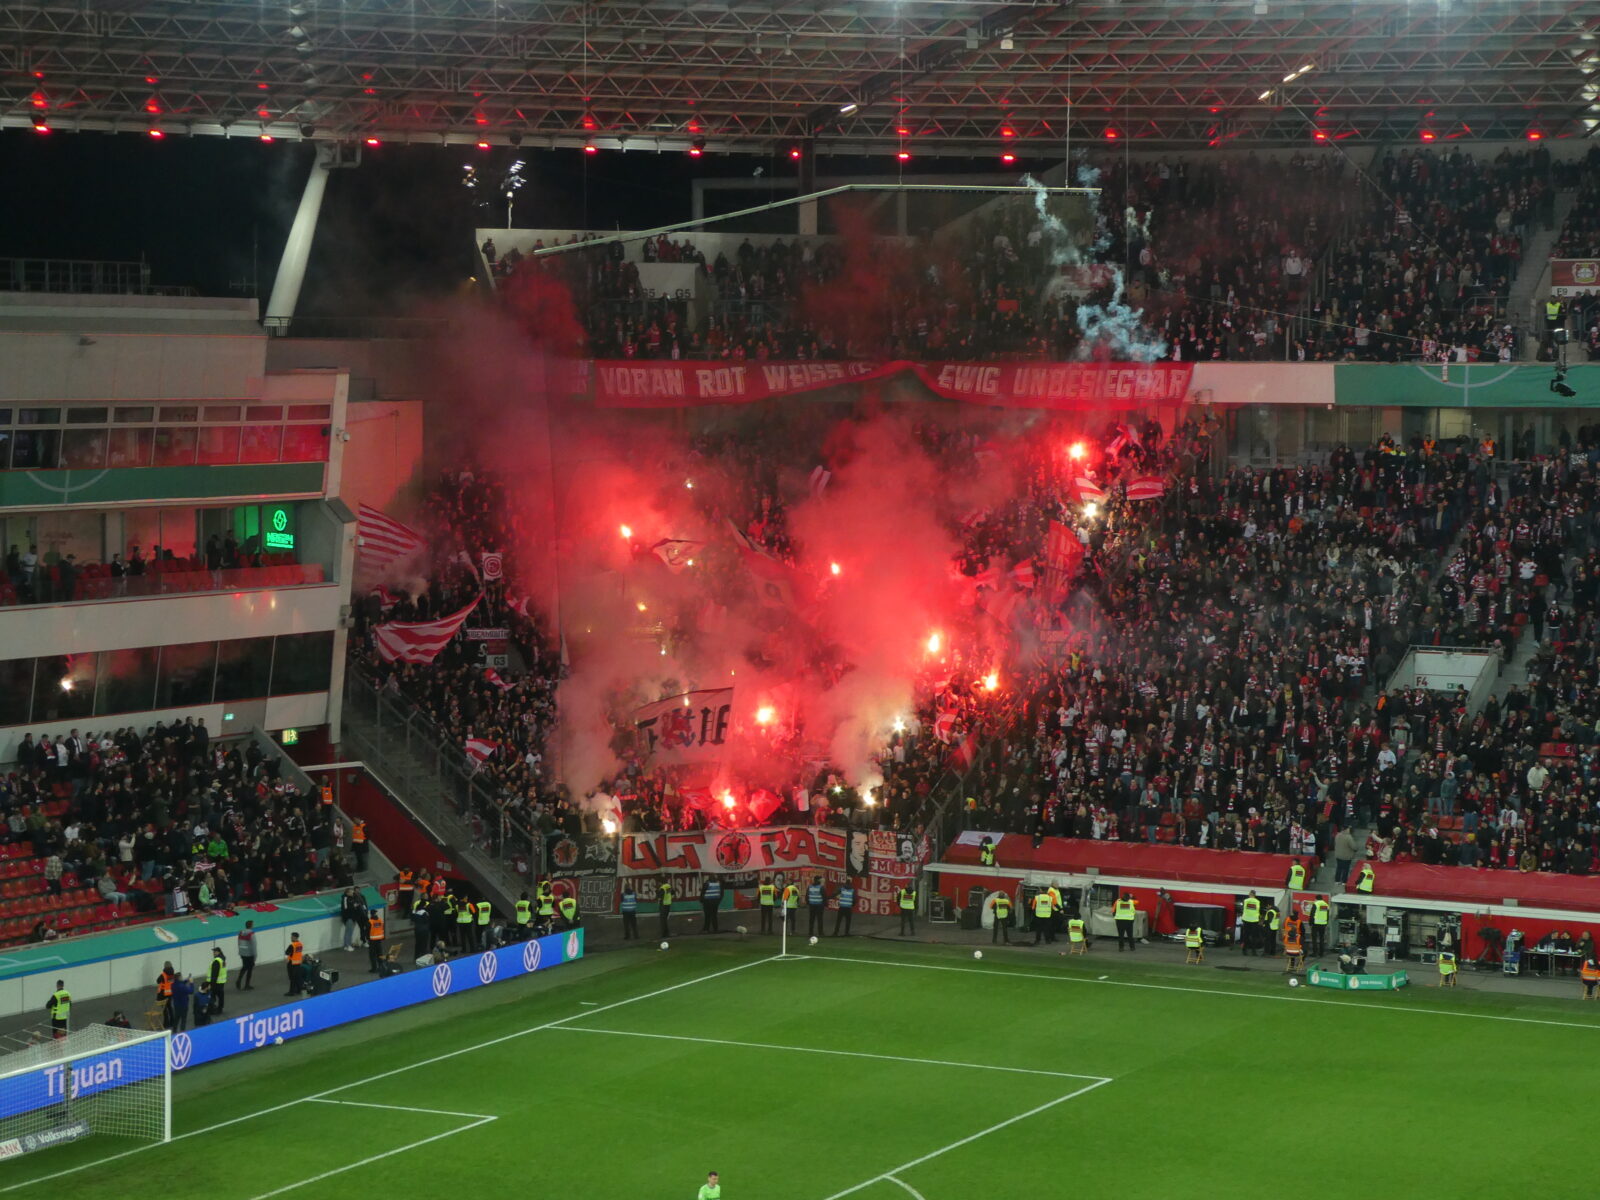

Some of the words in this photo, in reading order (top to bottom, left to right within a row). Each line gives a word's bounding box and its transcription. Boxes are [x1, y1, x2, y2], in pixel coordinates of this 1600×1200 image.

[600, 367, 684, 395] VORAN
[696, 366, 746, 397] ROT
[762, 363, 844, 391] WEISS
[938, 364, 1001, 395] EWIG
[1012, 367, 1187, 399] UNBESIEGBAR
[1416, 676, 1428, 687] F4
[236, 1008, 304, 1047] Tiguan
[44, 1057, 122, 1099] Tiguan
